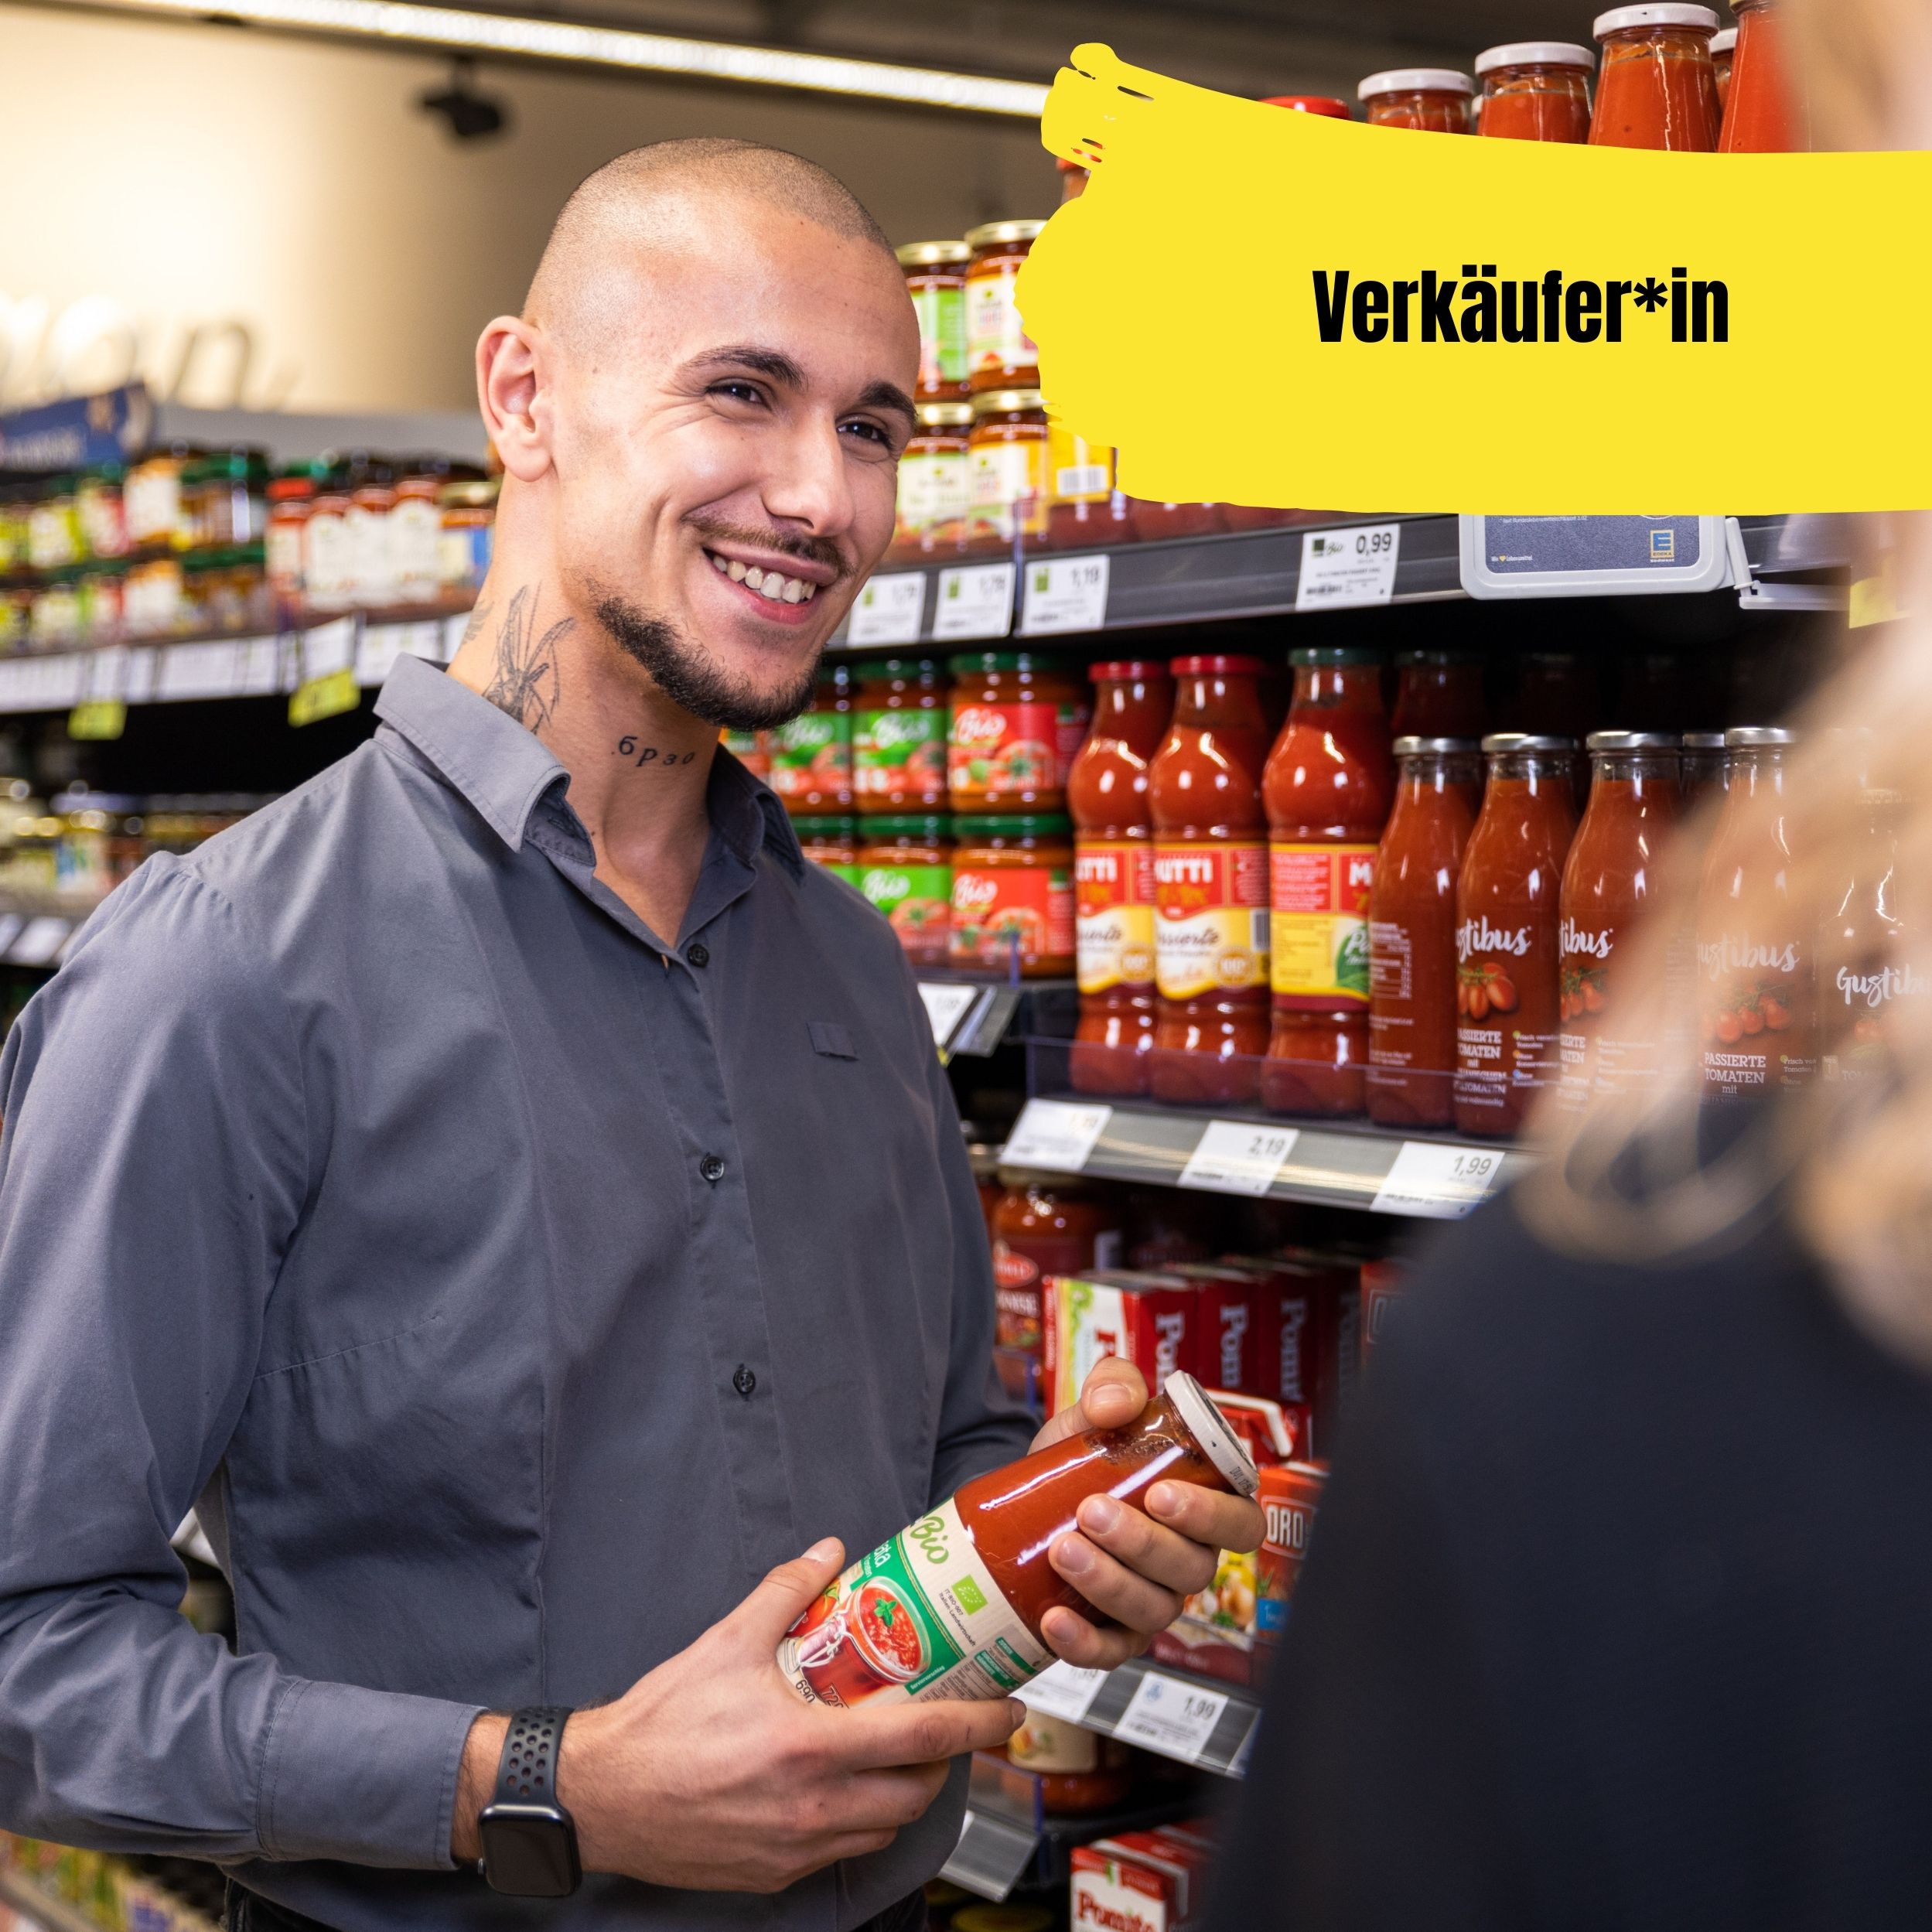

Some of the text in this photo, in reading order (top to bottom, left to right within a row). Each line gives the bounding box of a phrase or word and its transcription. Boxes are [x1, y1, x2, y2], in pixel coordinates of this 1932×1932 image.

[1356, 531, 1392, 556] 0,99
[1155, 858, 1213, 883] UTTI
[1558, 917, 1614, 964] tibus
[1698, 932, 1801, 982] ustibus
[1458, 1028, 1502, 1044] ASSIERTE
[1458, 1042, 1501, 1060] OMATEN
[1705, 1053, 1766, 1068] PASSIERTE
[1705, 1067, 1765, 1084] TOMATEN
[1722, 1085, 1737, 1094] mit
[1453, 1155, 1493, 1176] 1,99
[1266, 1504, 1304, 1548] ORO
[910, 1516, 949, 1564] Bio
[944, 1588, 964, 1616] IT-BIO-007
[1184, 1695, 1217, 1722] 1,99
